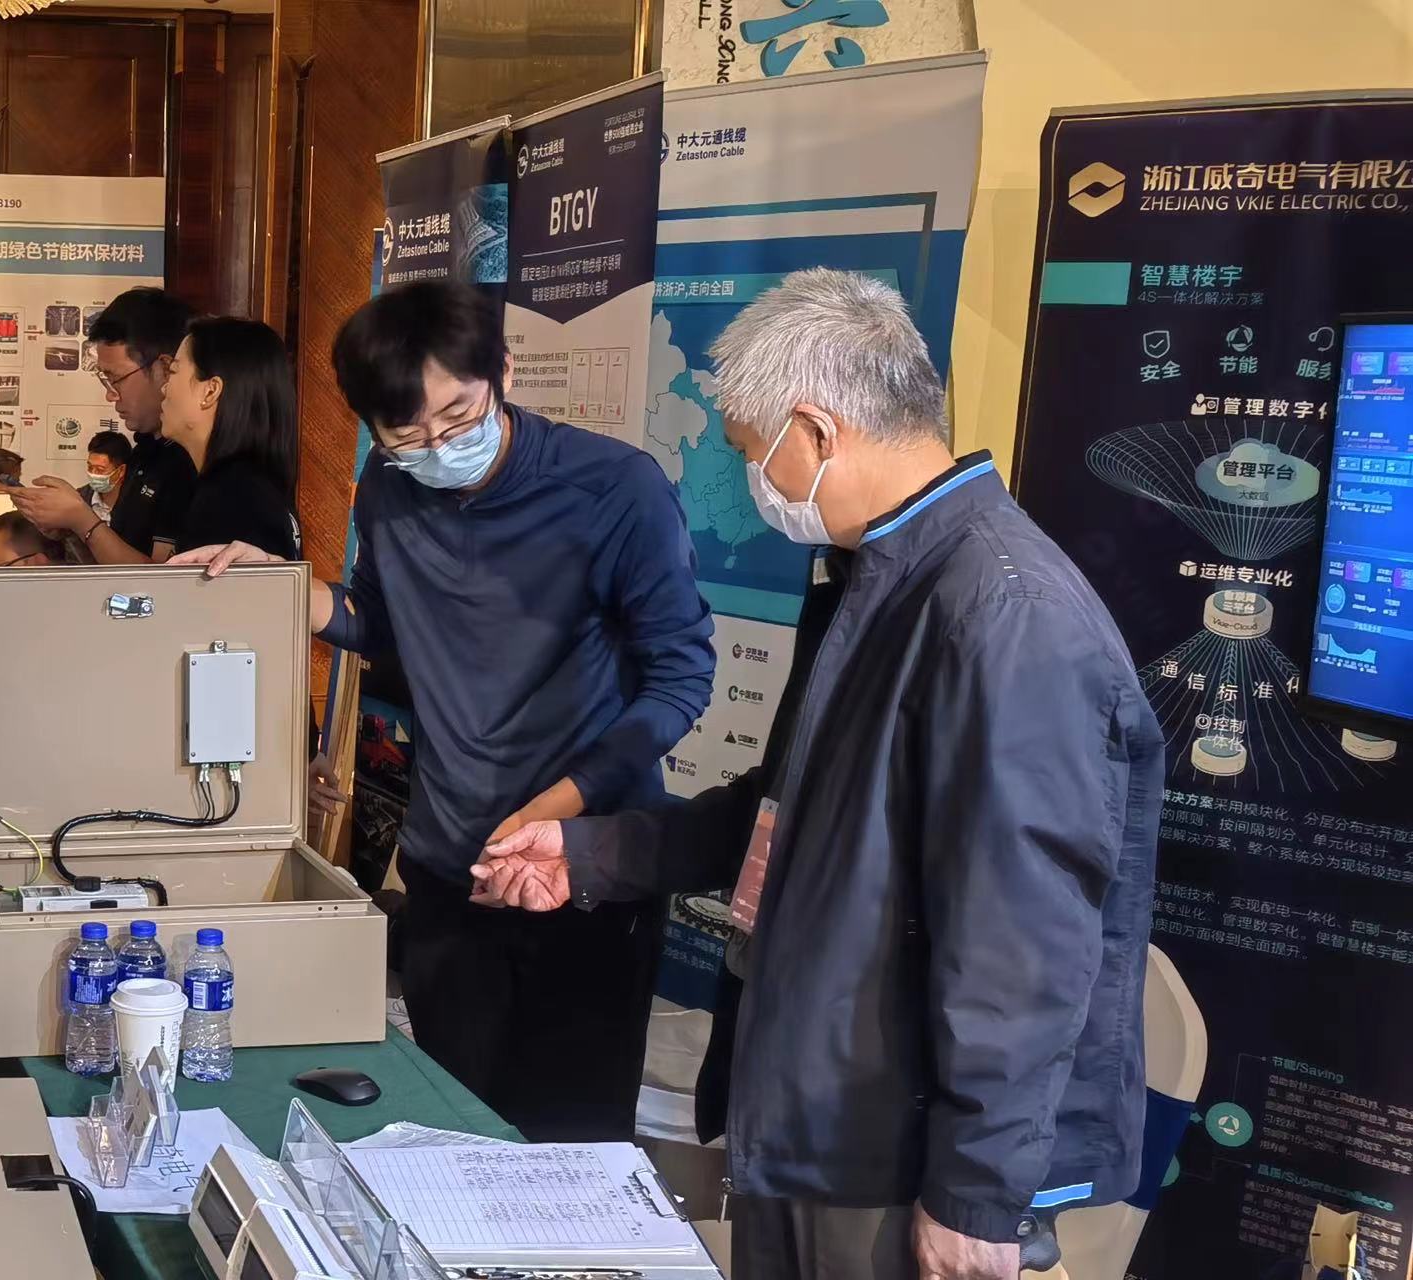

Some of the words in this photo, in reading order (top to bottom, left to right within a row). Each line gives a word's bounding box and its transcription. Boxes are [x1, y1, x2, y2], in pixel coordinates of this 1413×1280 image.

[676, 126, 746, 149] 中大元通线缆
[676, 149, 719, 162] Zetastone
[720, 146, 745, 158] Cable
[549, 186, 599, 236] BTGY
[1140, 196, 1229, 211] ZHEJIANG
[1236, 195, 1275, 211] VKIE
[1280, 194, 1366, 210] ELECTRIC
[398, 212, 451, 241] 中大元通线缆
[429, 238, 450, 254] Cable
[1141, 264, 1243, 287] 智慧楼宇
[1138, 291, 1264, 306] 4S一体化解决方案
[1140, 361, 1182, 382] 安全
[1219, 356, 1258, 374] 节能
[1223, 460, 1295, 481] 管理平台
[1200, 562, 1292, 587] 运维专业化
[1212, 716, 1246, 734] 控制
